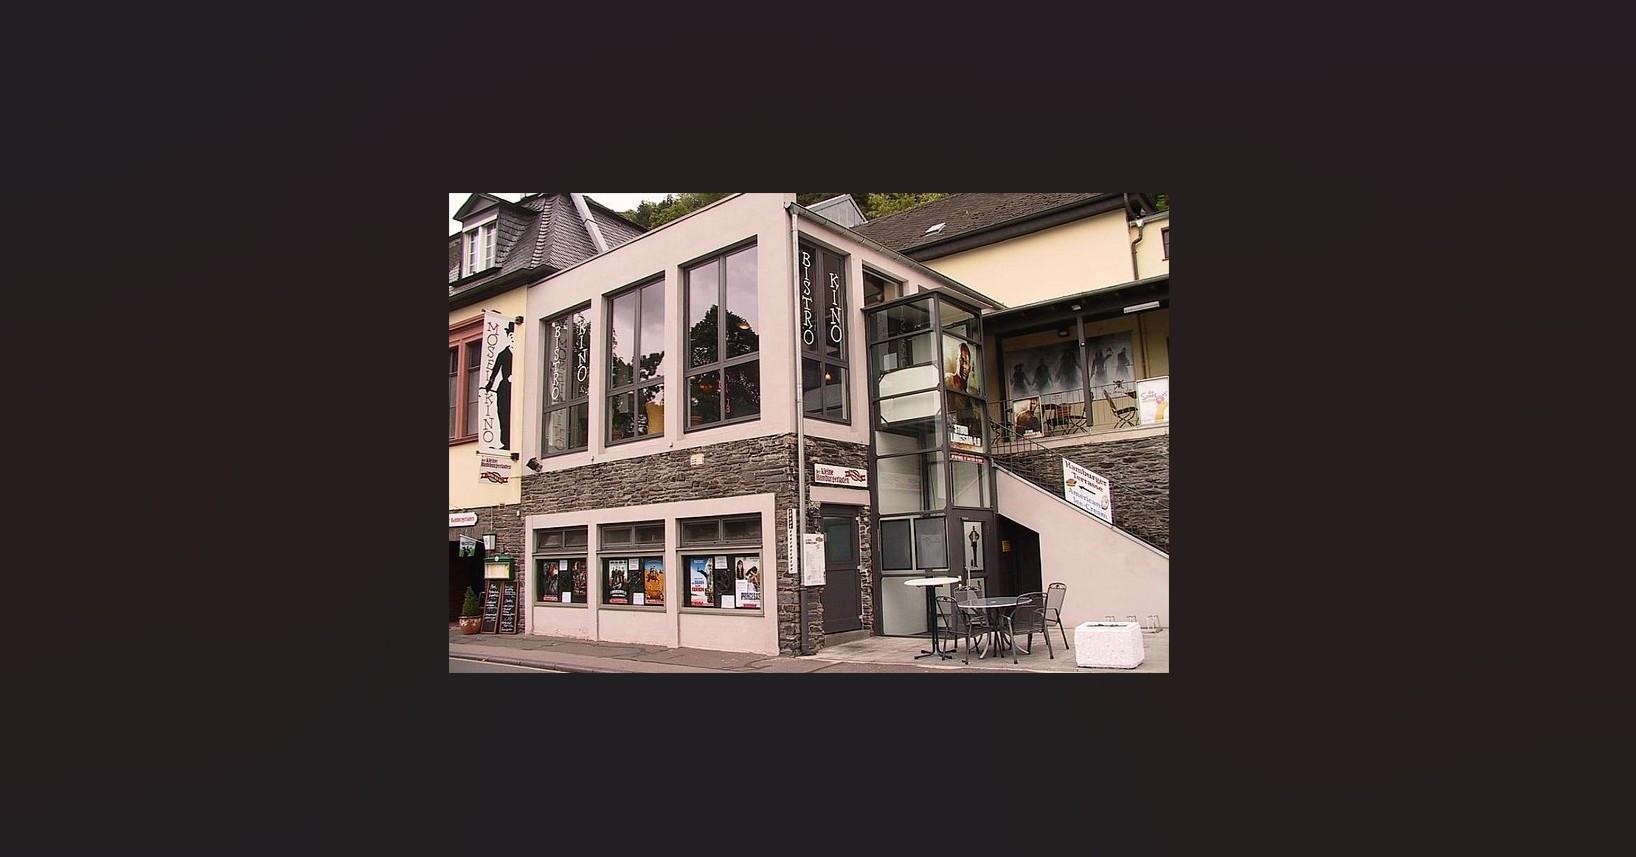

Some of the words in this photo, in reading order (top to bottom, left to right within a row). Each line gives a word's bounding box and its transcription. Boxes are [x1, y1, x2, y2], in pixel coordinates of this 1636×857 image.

[802, 251, 814, 345] BISTRO
[829, 272, 842, 343] KINO
[552, 325, 560, 400] BISTRO
[577, 321, 588, 382] KINO
[483, 393, 494, 444] KINO
[1065, 460, 1107, 487] Hamburger
[1072, 471, 1104, 493] Terrasse
